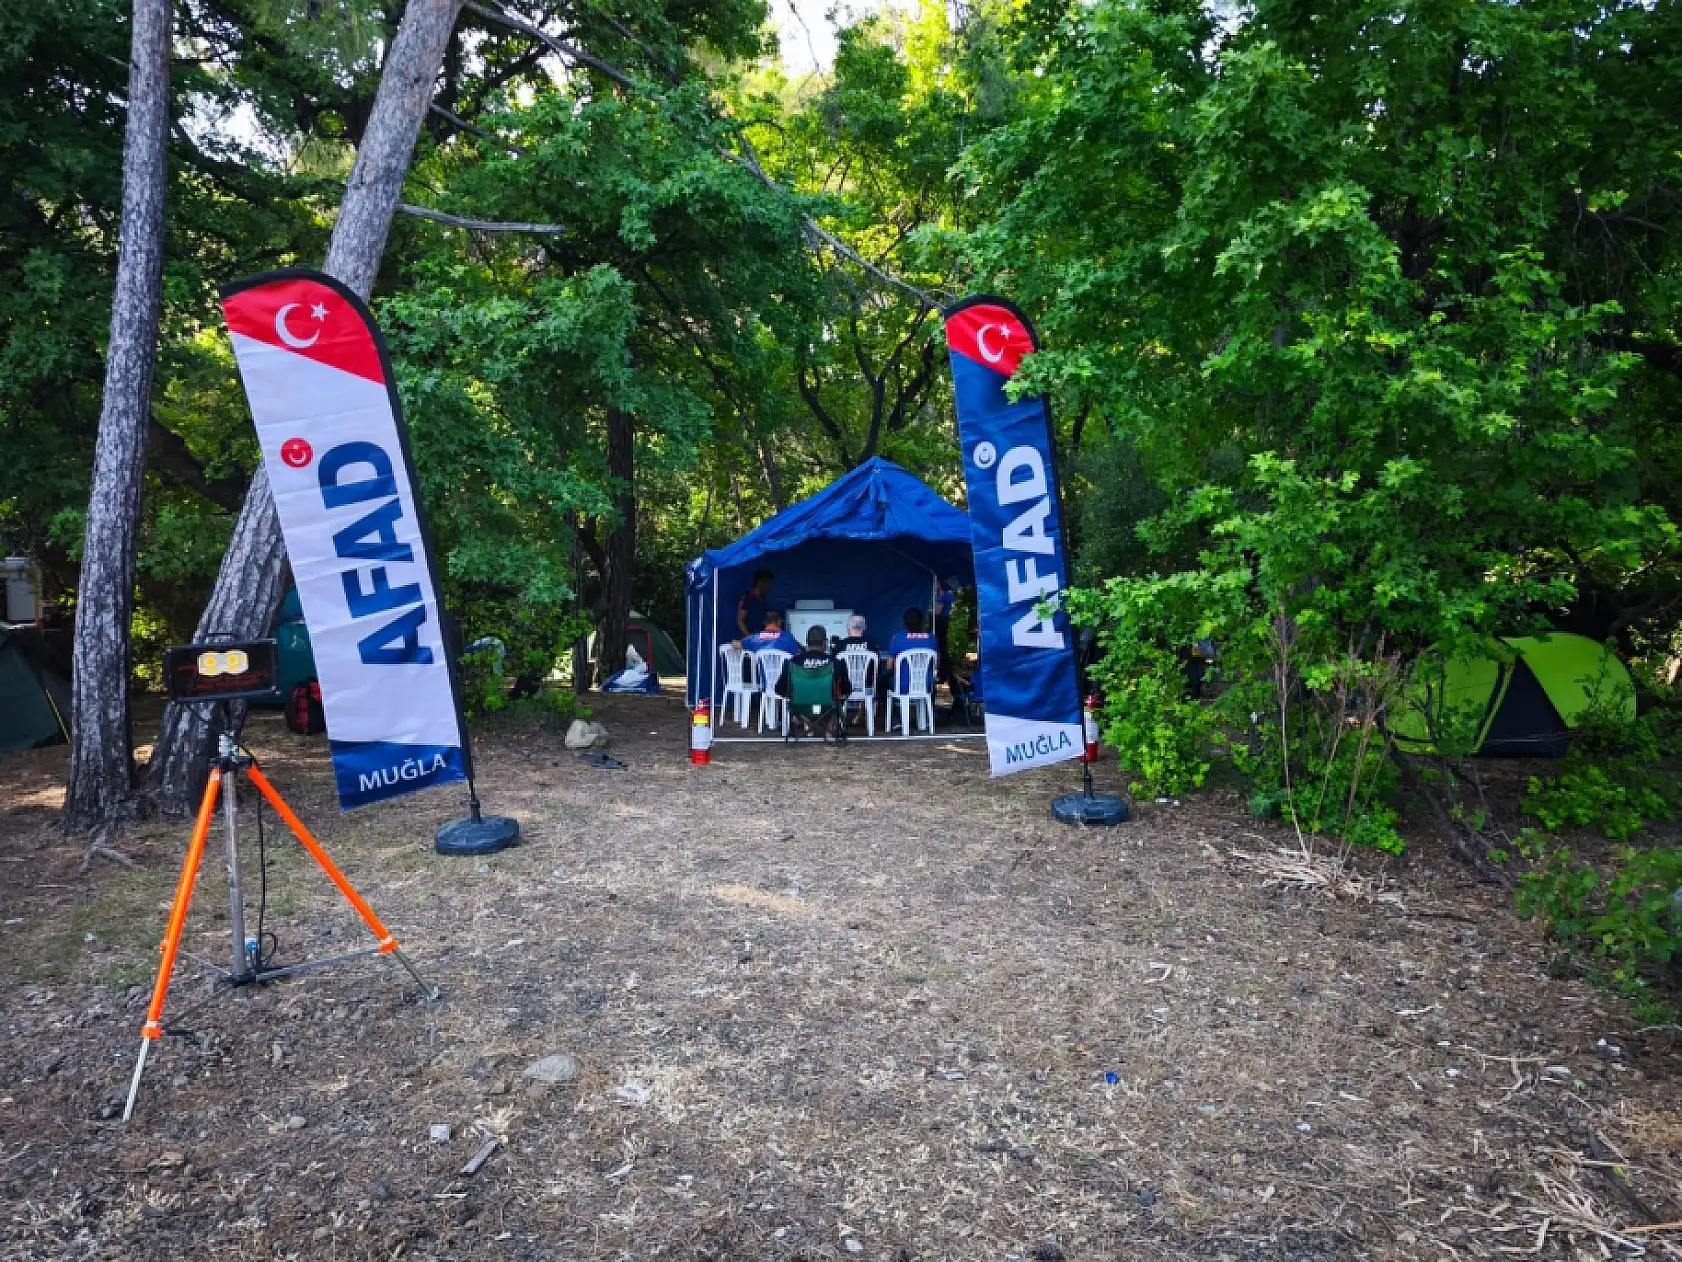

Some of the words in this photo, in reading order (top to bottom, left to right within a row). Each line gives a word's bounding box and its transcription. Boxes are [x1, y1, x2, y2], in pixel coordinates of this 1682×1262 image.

[318, 440, 434, 665] AFAD
[996, 444, 1065, 649] AFAD
[357, 752, 447, 792] MUĞLA
[1005, 730, 1072, 764] MUĞLA
